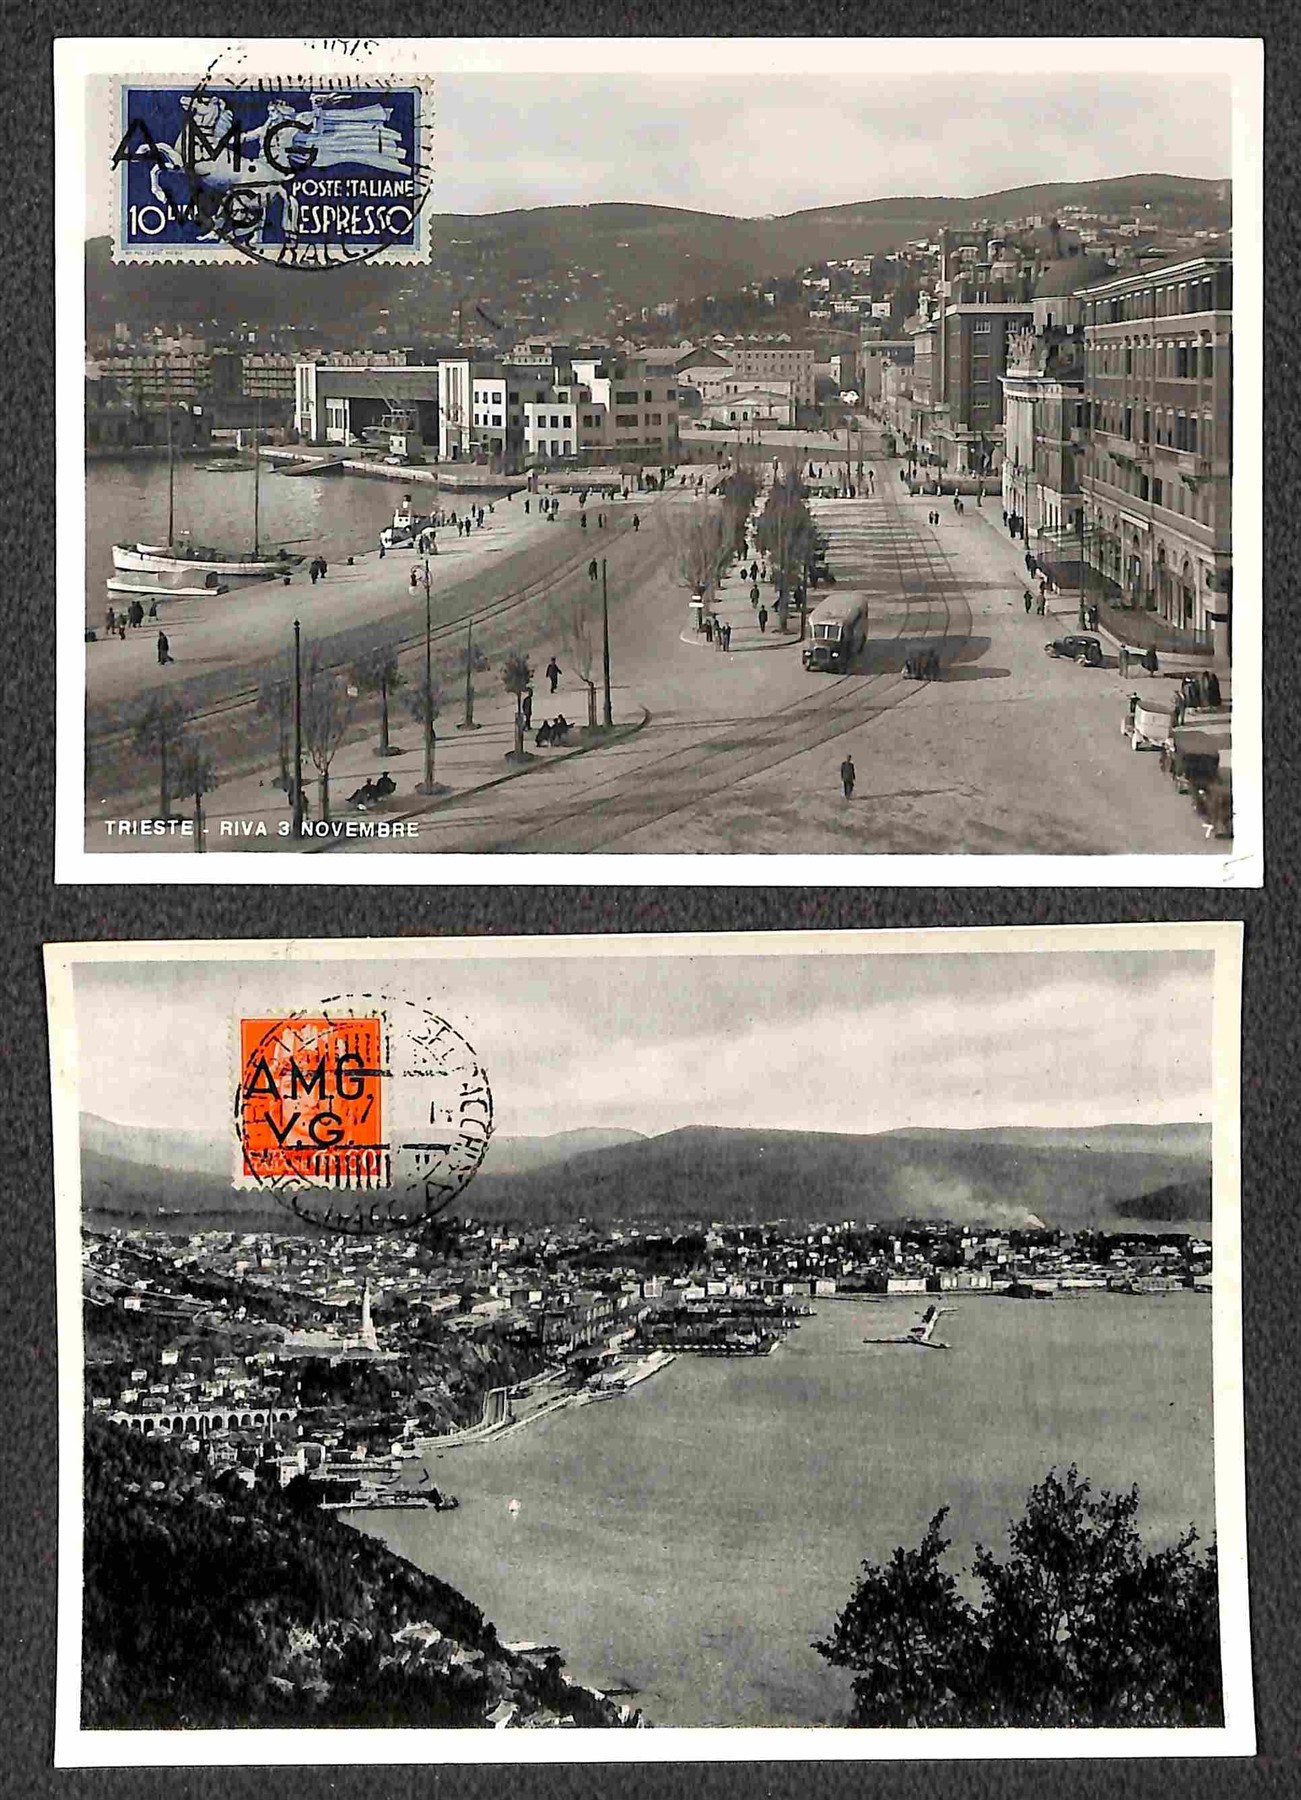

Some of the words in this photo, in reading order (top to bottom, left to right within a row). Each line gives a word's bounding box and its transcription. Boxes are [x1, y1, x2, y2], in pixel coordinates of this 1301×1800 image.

[293, 180, 341, 197] POSTE
[346, 180, 414, 197] ITALIANE
[129, 204, 166, 236] 10
[300, 204, 413, 235] ESPRESSO
[104, 819, 194, 836] TRIESTE
[219, 819, 268, 837] RIVA
[278, 819, 291, 837] 3
[301, 819, 420, 838] NOVEMBRE
[1201, 823, 1215, 839] 7
